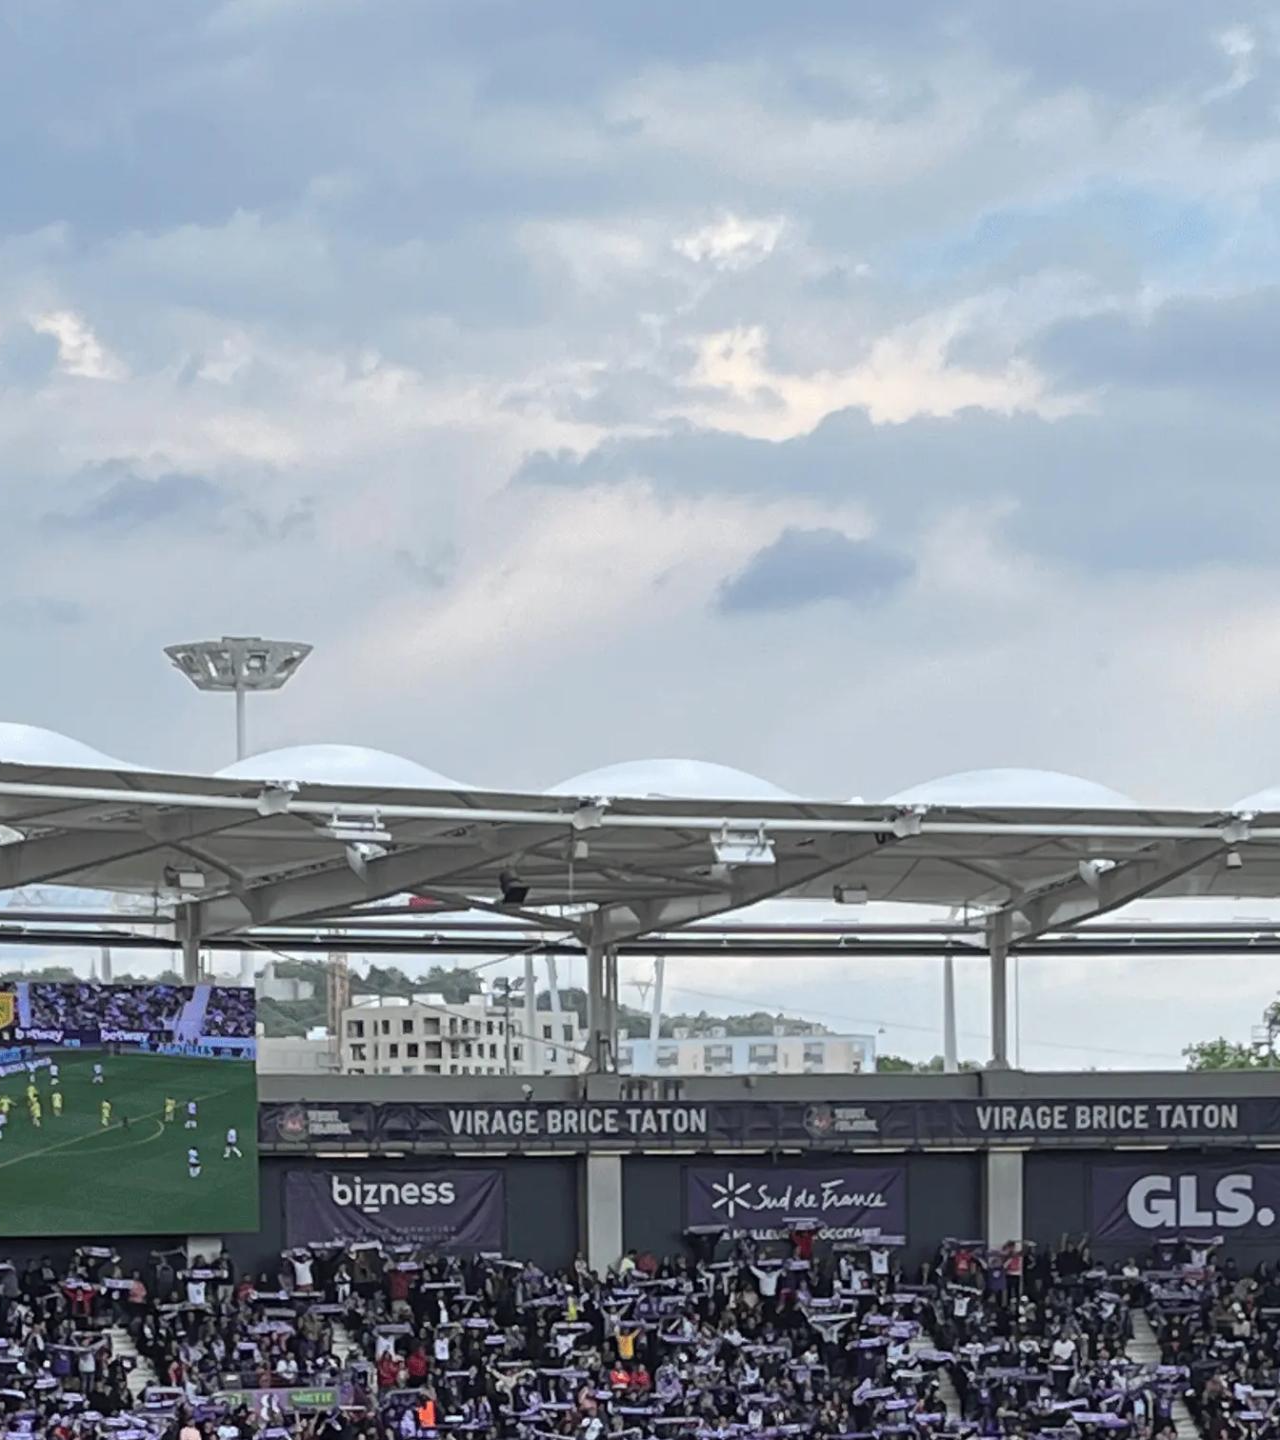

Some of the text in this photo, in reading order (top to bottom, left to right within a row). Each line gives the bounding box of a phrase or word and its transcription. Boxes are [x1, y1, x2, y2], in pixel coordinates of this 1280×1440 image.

[448, 1107, 707, 1135] VIRAGE BRICE TATON
[976, 1103, 1239, 1131] VIRAGE BRICE TATON
[331, 1175, 457, 1213] bizness
[820, 1178, 888, 1212] France
